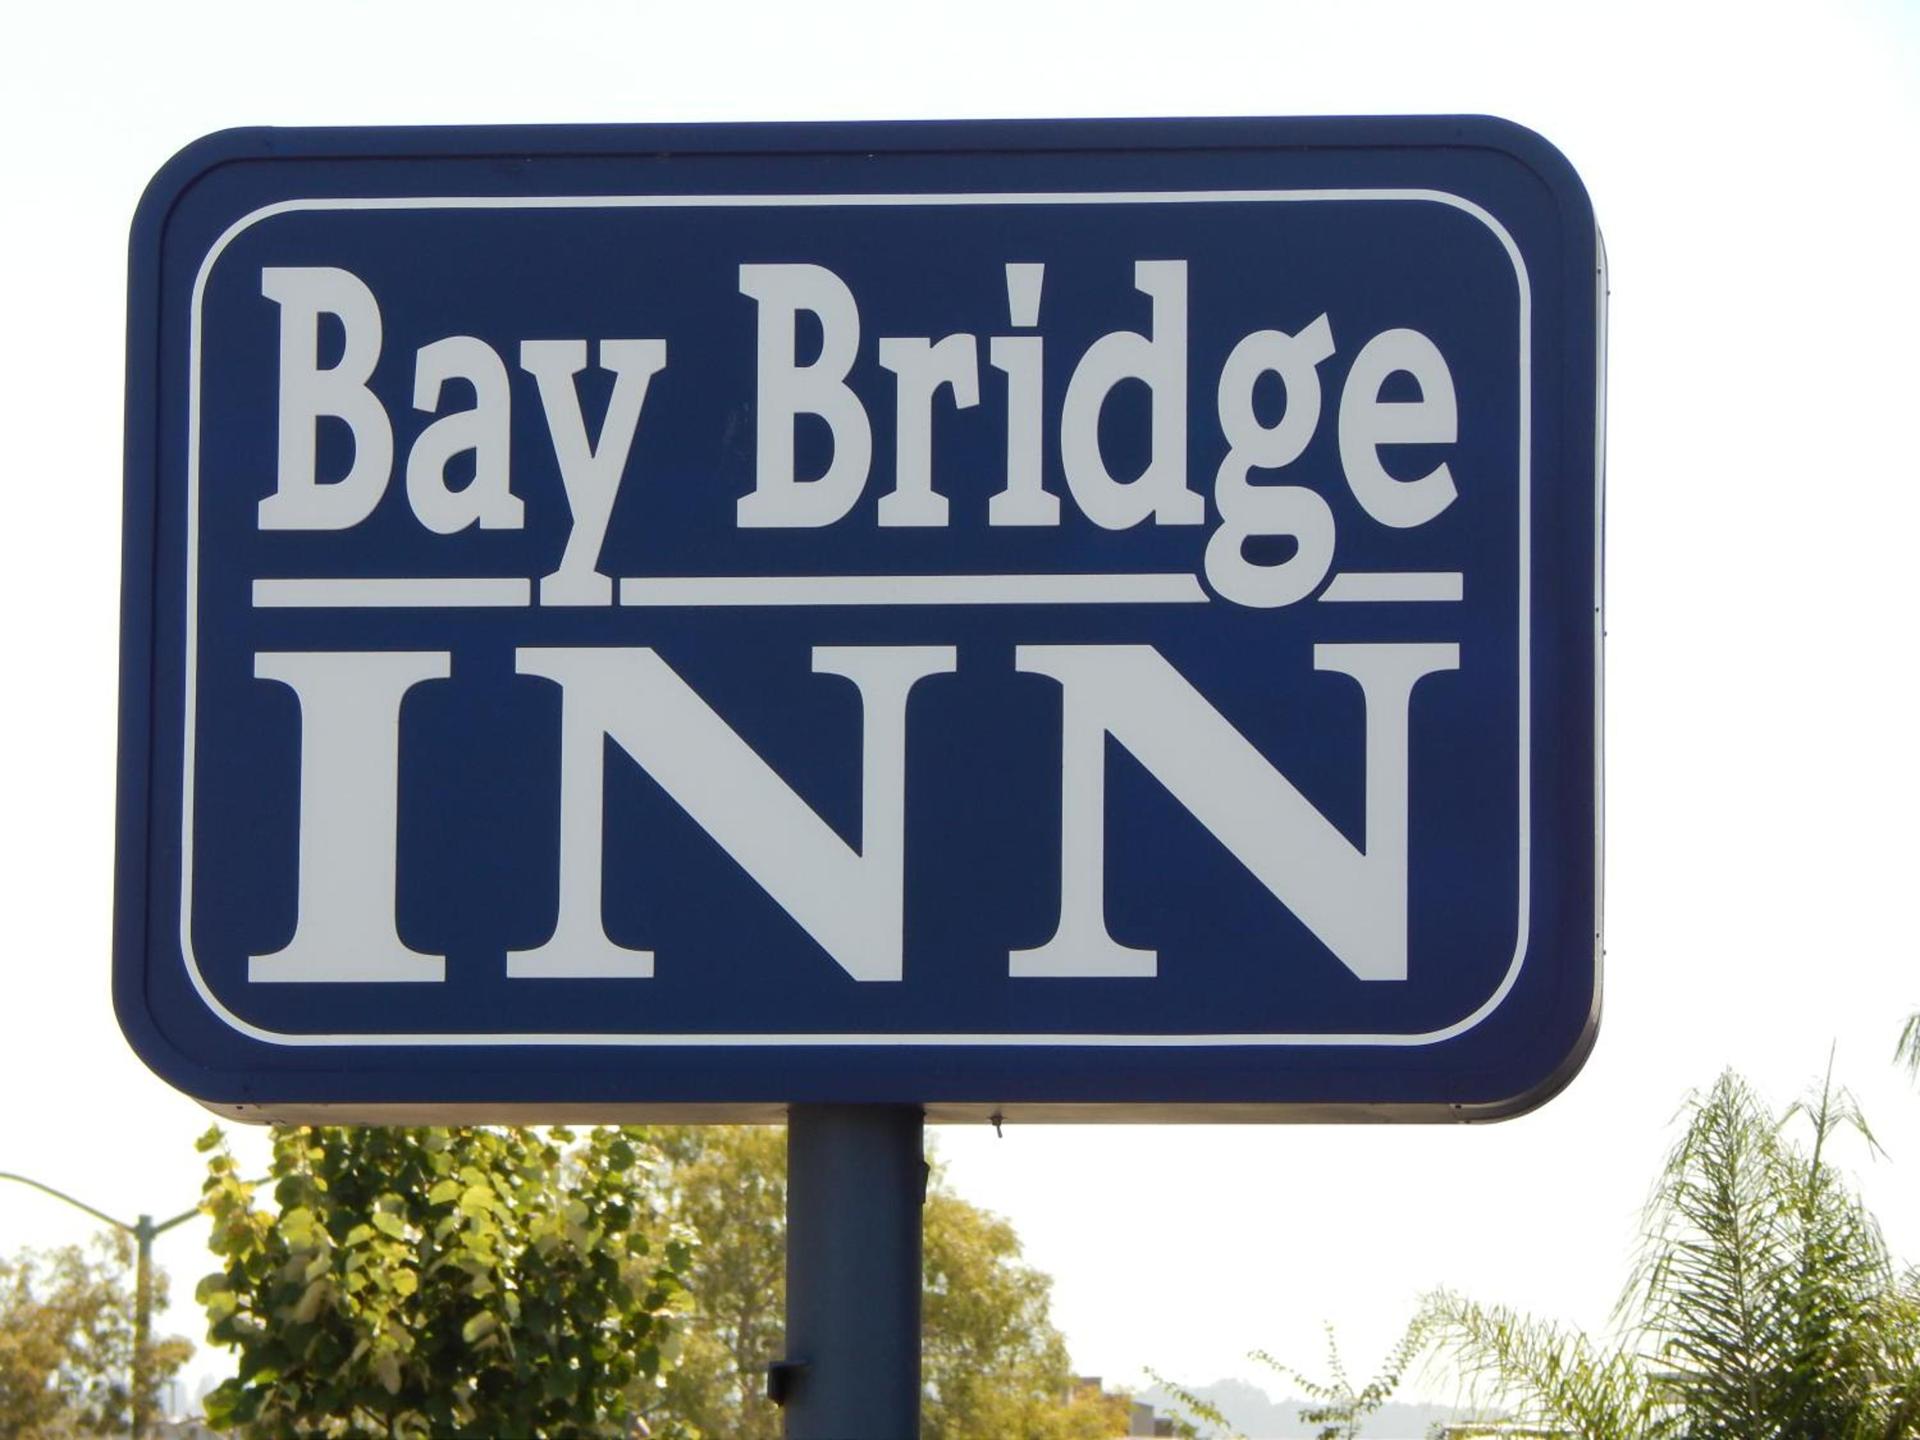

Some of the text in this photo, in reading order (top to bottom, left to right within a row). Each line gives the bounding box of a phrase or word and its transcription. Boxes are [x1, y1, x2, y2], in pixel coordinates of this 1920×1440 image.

[257, 259, 1459, 609] Bay Bridge
[247, 642, 1461, 983] INN
